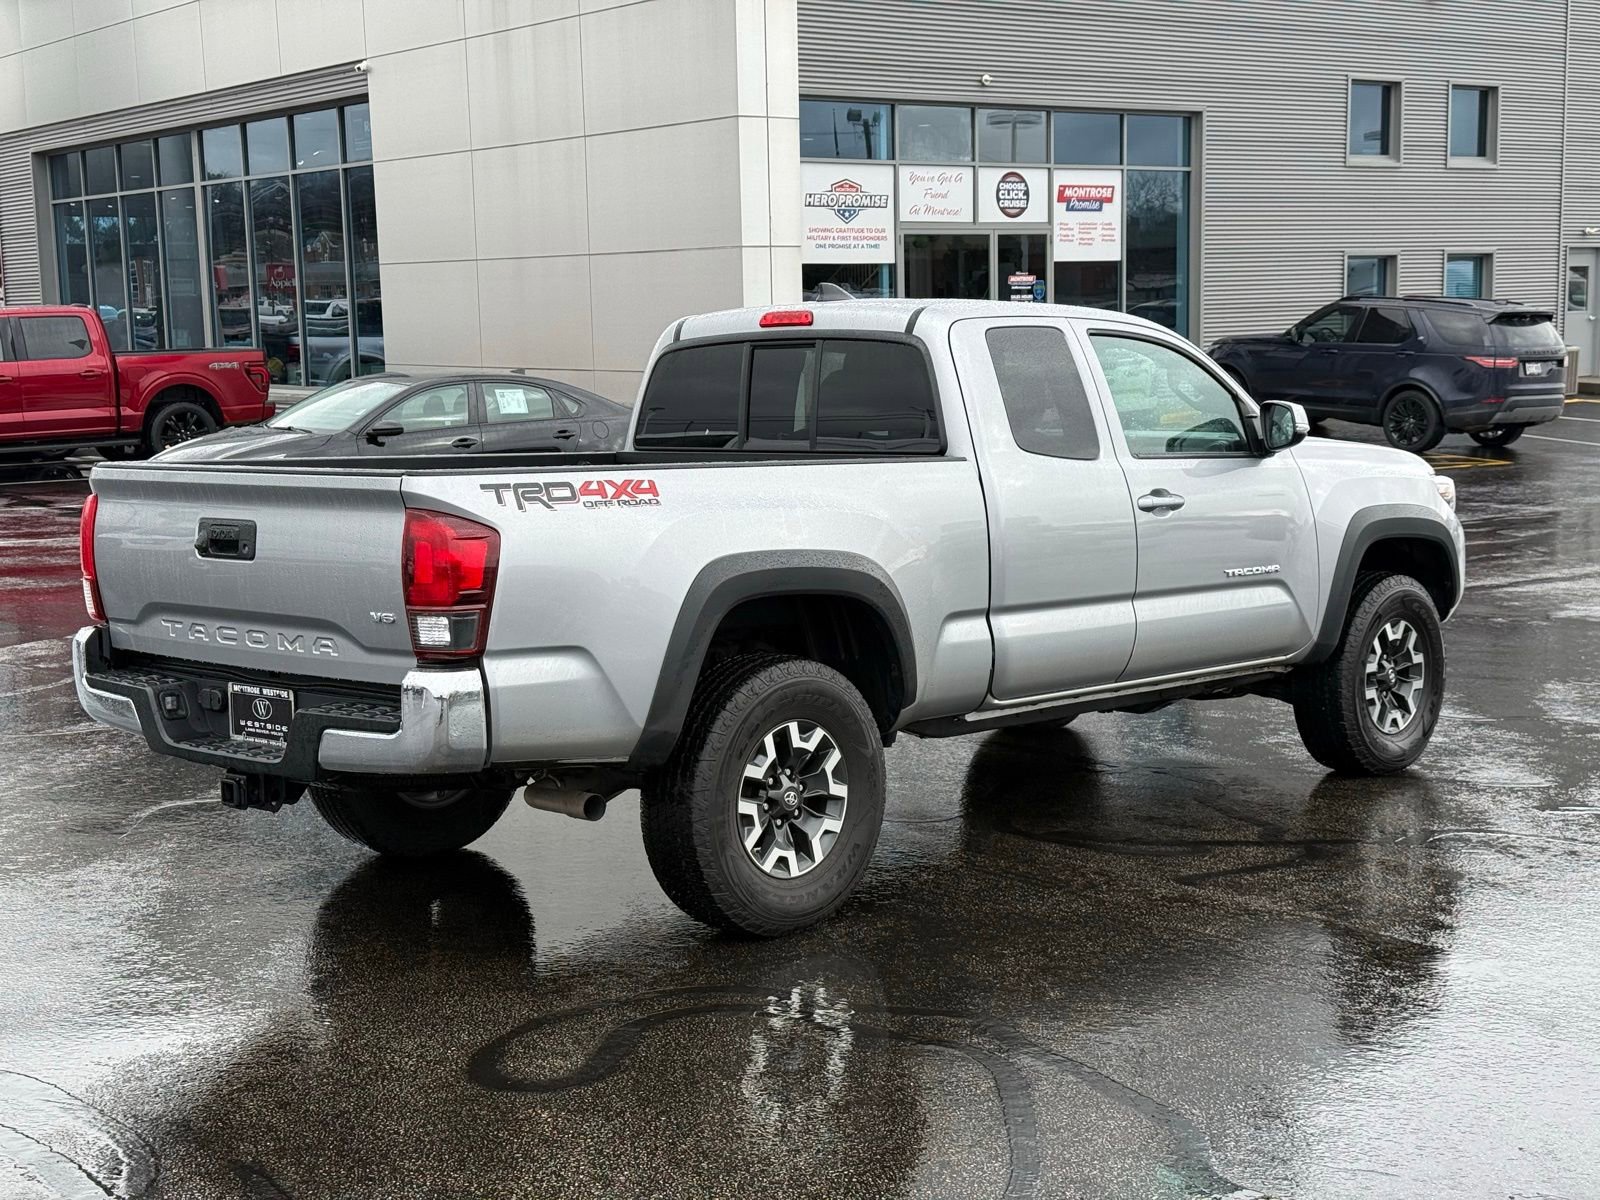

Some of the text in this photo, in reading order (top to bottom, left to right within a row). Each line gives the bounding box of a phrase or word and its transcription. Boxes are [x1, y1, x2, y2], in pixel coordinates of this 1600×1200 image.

[909, 171, 963, 185] You've Got A
[999, 182, 1027, 190] CHOOSE.
[1063, 187, 1113, 198] MONTROSE
[924, 188, 950, 199] Friend
[999, 190, 1027, 199] CLICK.
[805, 193, 888, 208] HERO PROMISE
[999, 200, 1027, 208] CRUISE!
[1069, 198, 1101, 210] Promise
[909, 203, 962, 216] At Montrose!
[479, 481, 580, 512] TRD
[583, 498, 661, 509] OFF ROAD
[1223, 564, 1281, 578] TACOMA
[370, 611, 397, 624] V6
[161, 619, 338, 656] TACOMA
[240, 719, 288, 732] WESTSIDE
